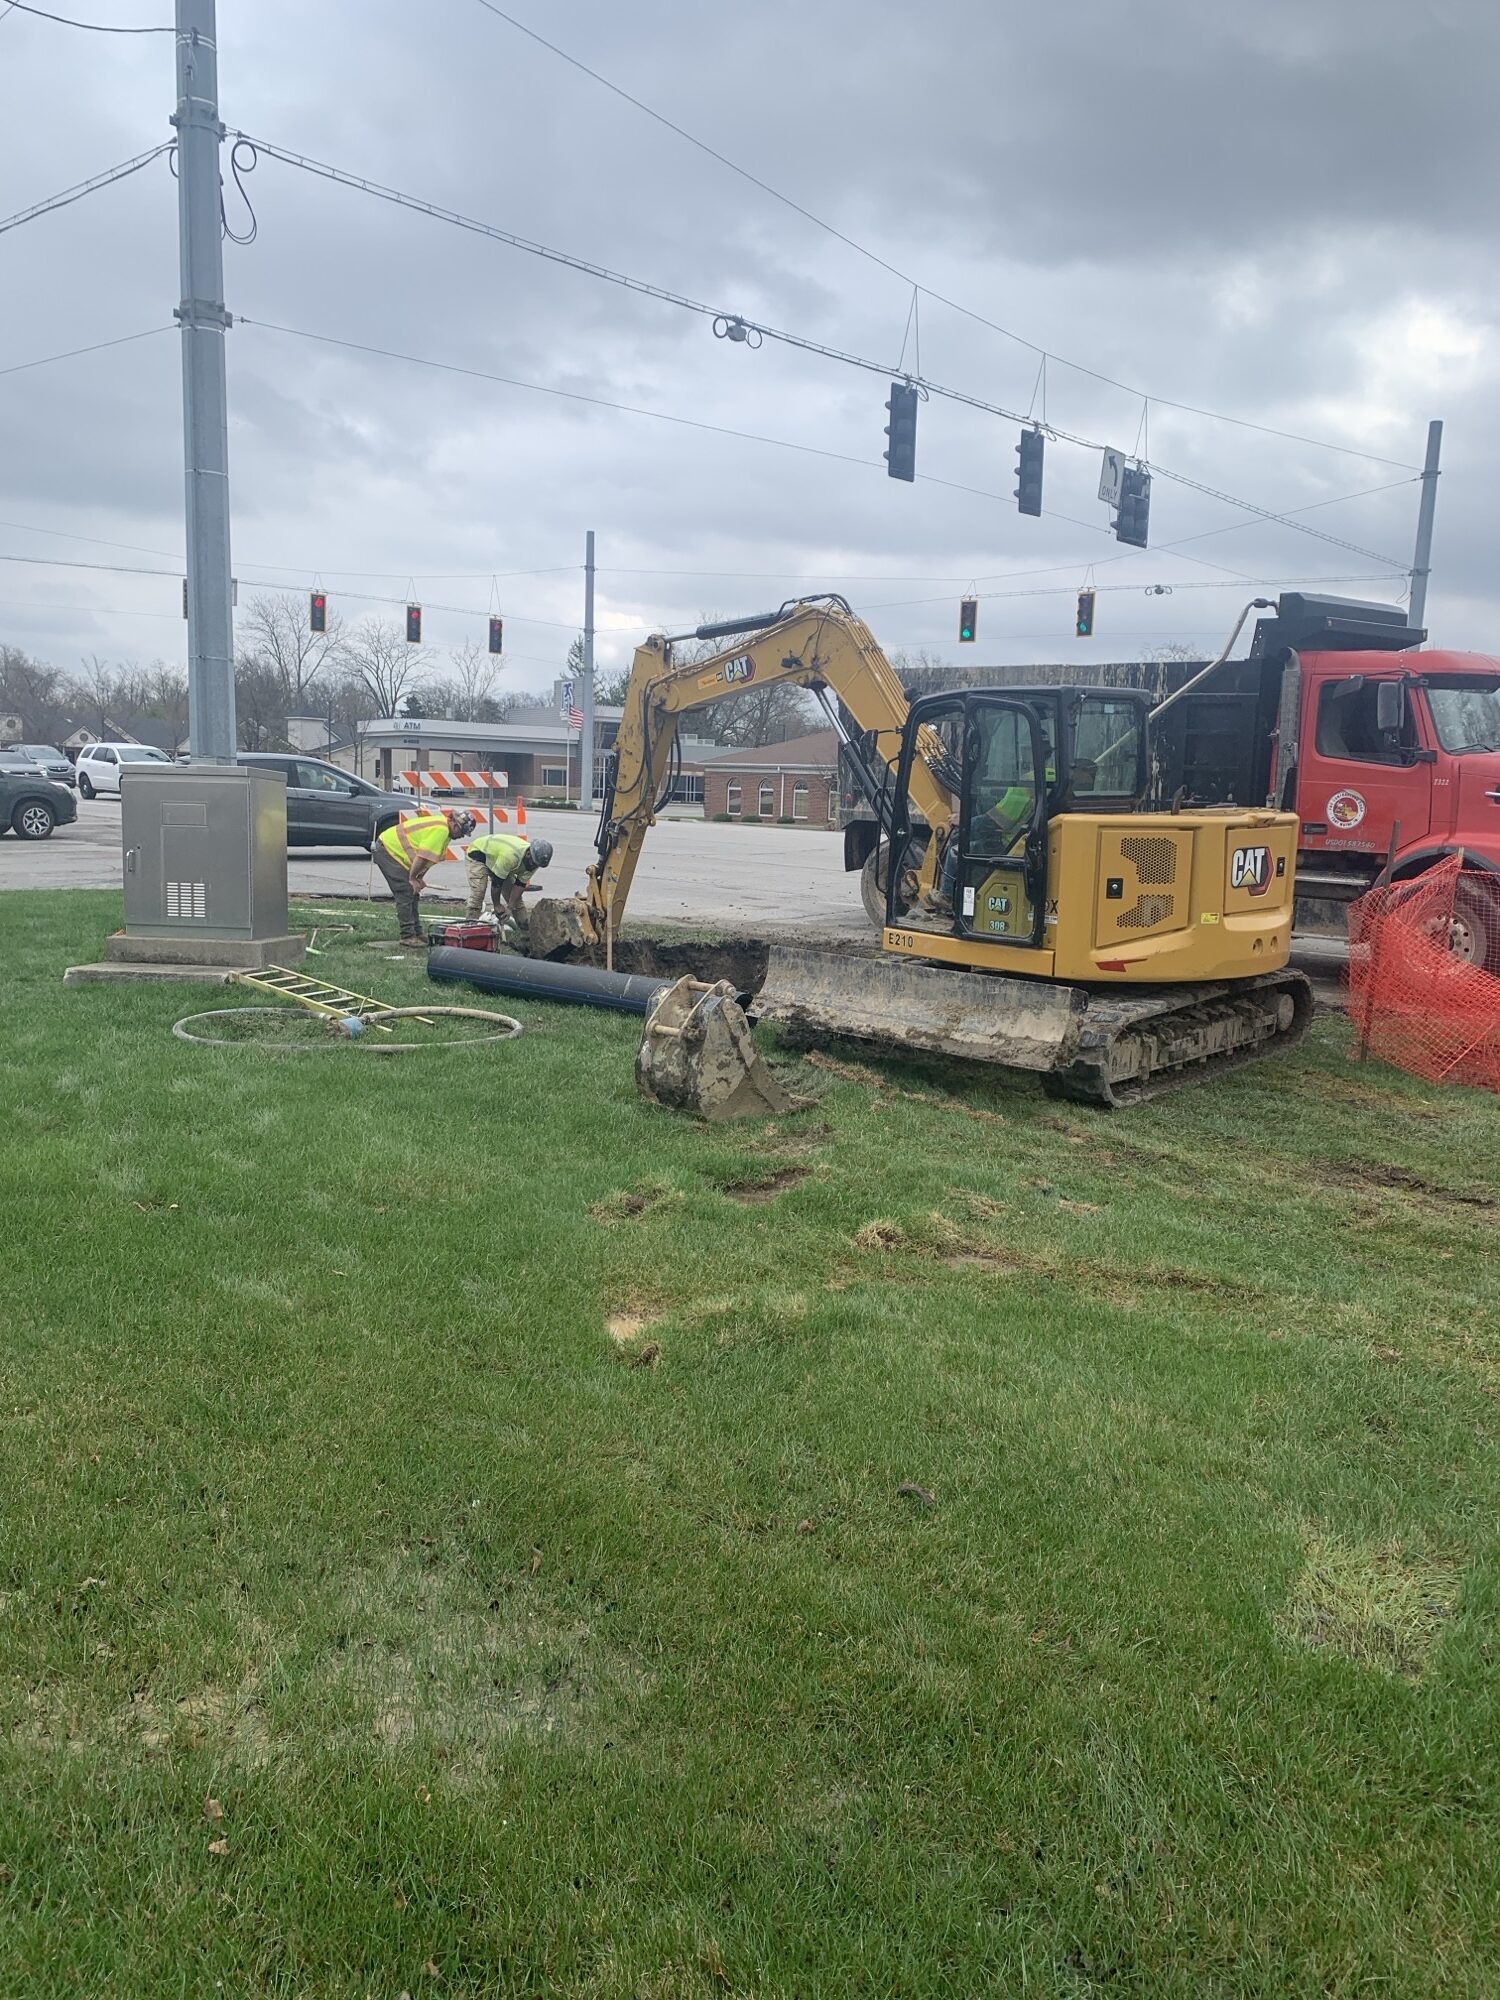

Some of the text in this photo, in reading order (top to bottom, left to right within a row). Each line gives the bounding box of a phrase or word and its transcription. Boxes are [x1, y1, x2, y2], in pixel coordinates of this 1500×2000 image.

[1102, 485, 1118, 499] ONLY
[725, 655, 748, 682] CAT
[404, 722, 420, 730] ATM
[1231, 848, 1266, 888] CAT
[988, 897, 1008, 911] CAT
[989, 920, 1006, 931] 308
[888, 932, 914, 948] E210
